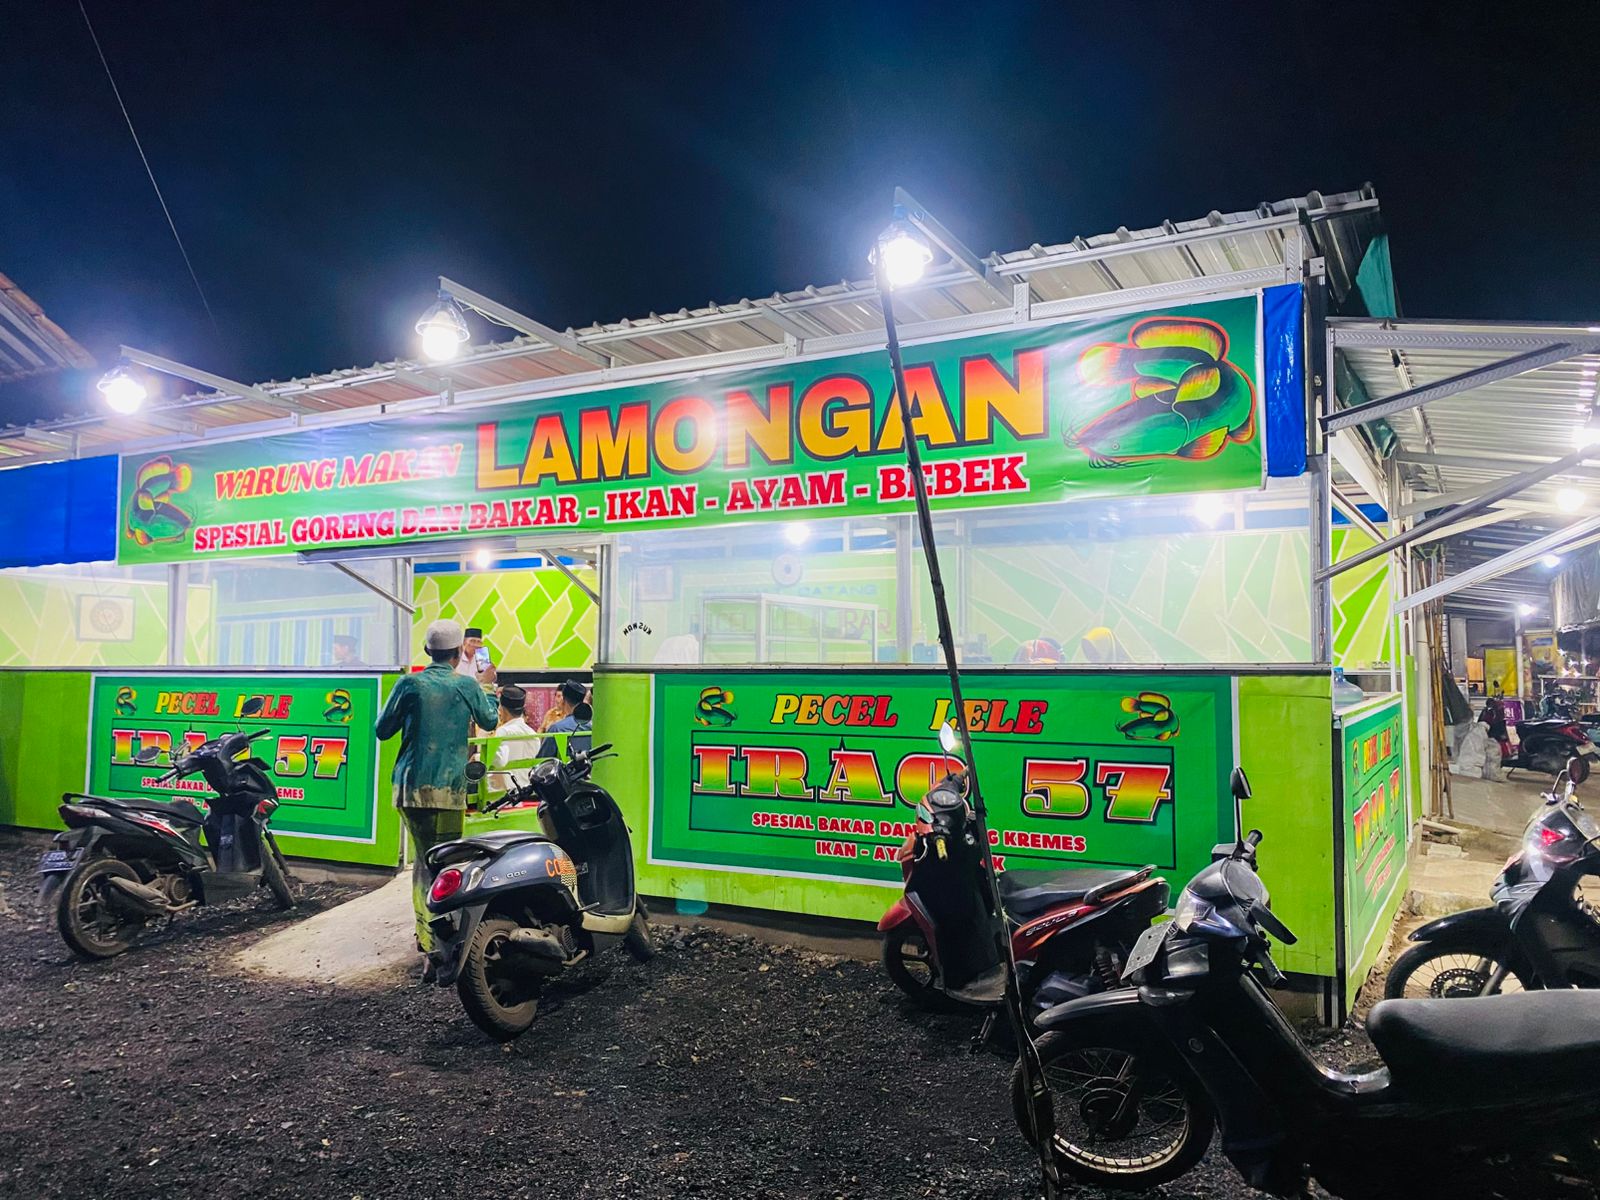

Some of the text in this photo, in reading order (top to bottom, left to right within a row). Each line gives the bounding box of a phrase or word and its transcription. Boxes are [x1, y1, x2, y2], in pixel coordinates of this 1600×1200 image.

[475, 346, 1050, 492] LAMONGAN
[214, 443, 463, 501] WARUNG MAKAN
[193, 519, 286, 552] SPESIAL
[290, 508, 396, 546] GORENG
[401, 504, 464, 535] DAN
[467, 496, 581, 532] BAKAR
[604, 483, 699, 523] IKAN
[723, 469, 847, 515] AYAM
[878, 452, 1029, 503] BEBEK
[154, 691, 293, 719] PECEL LLE
[770, 693, 1049, 735] PECEL LELE
[111, 729, 349, 780] IR 57
[175, 780, 205, 792] BAKAR
[276, 788, 305, 800] EMES
[1021, 756, 1172, 825] 57
[752, 812, 814, 830] SPESIAL
[818, 816, 876, 836] BAKAR
[879, 821, 917, 838] DAN
[1003, 830, 1086, 853] KREMES
[815, 841, 857, 859] IKAN
[873, 846, 901, 862] AY
